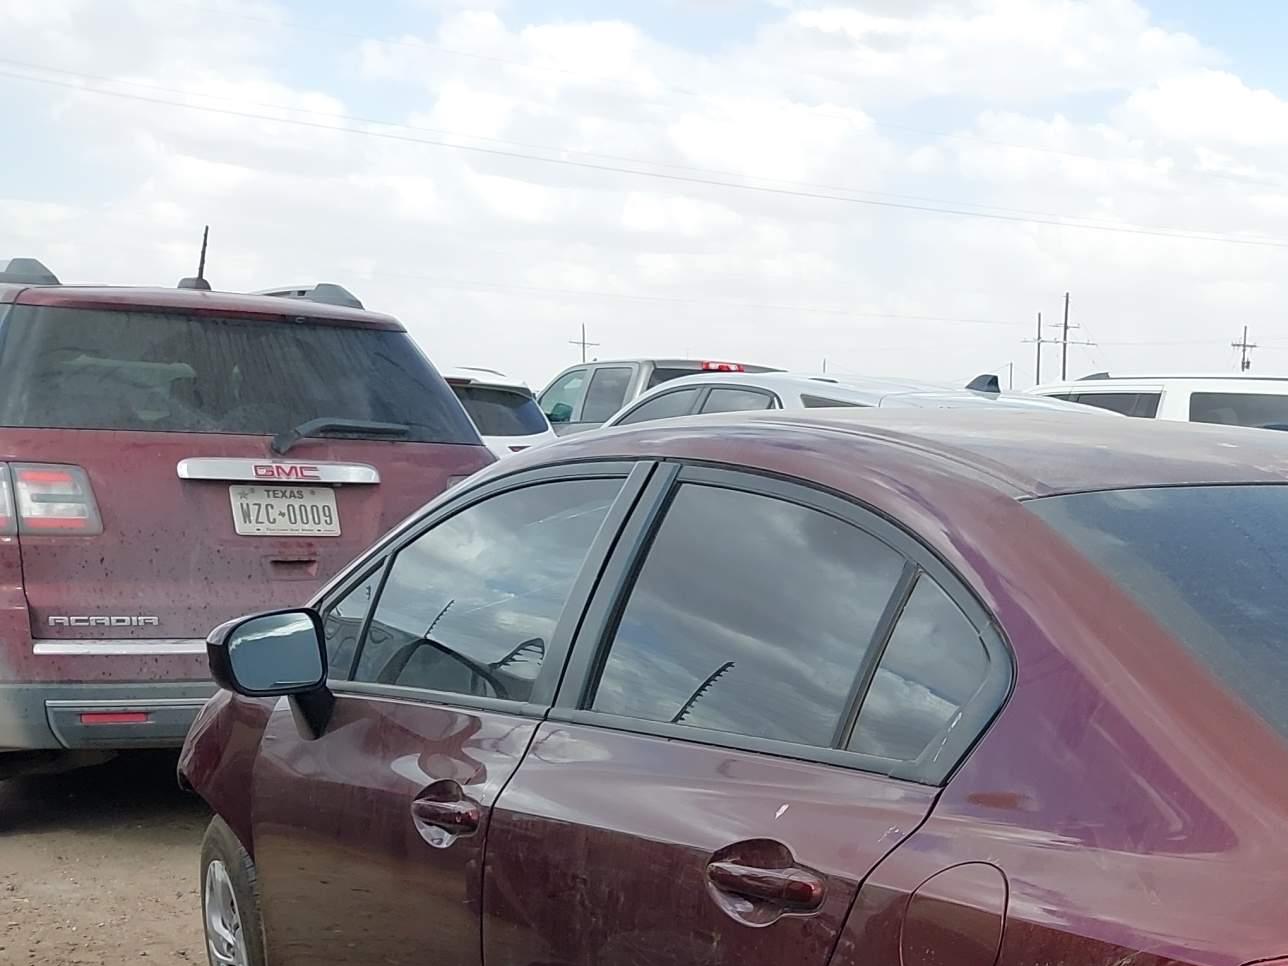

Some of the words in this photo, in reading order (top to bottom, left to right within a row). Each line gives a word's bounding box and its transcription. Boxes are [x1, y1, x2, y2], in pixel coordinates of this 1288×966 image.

[253, 464, 321, 481] GMC
[264, 489, 304, 499] TEXAS
[48, 616, 159, 626] ACADIA
